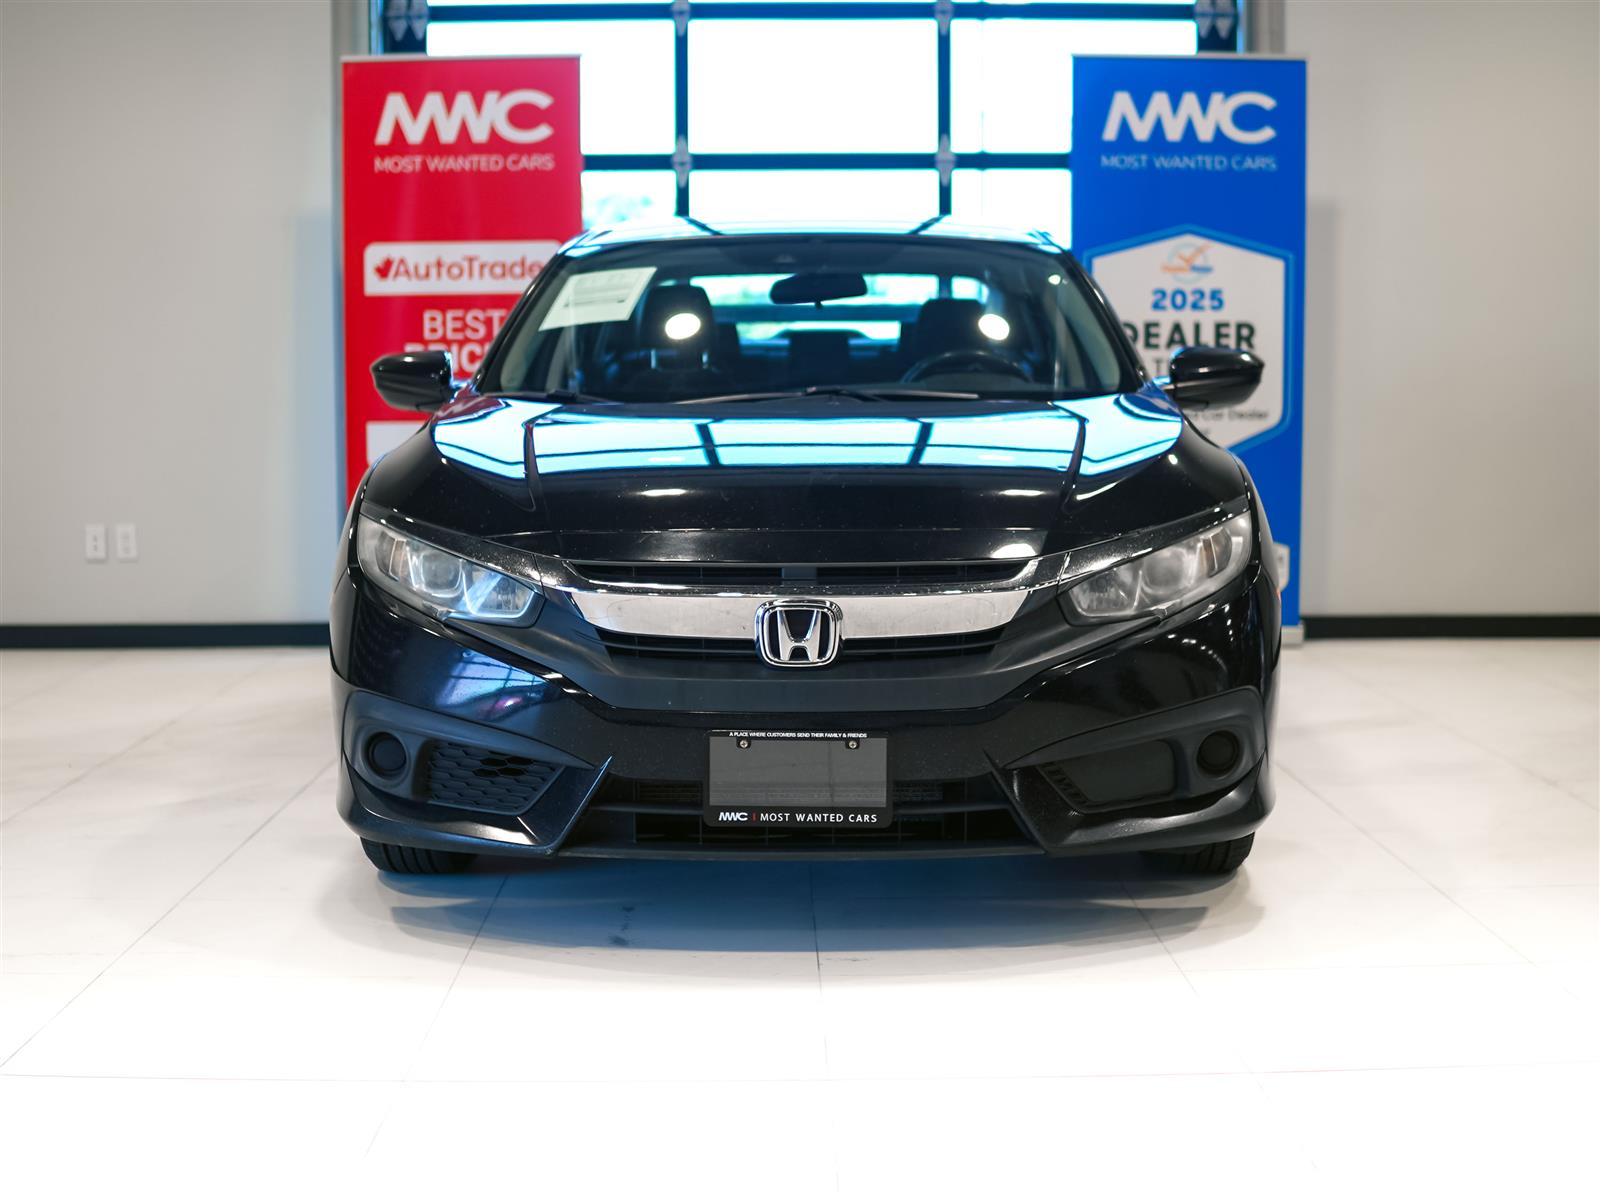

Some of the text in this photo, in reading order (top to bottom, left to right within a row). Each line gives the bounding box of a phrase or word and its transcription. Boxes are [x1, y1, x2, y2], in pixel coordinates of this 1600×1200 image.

[374, 89, 554, 145] MWC
[1102, 91, 1278, 144] MWC
[374, 153, 555, 173] MOST WANTED CARS
[1101, 154, 1278, 172] MOST WANTED CARS
[1151, 288, 1225, 311] 2025
[423, 308, 507, 340] BEST
[718, 811, 878, 823] MWC MOST WANTED CARS
